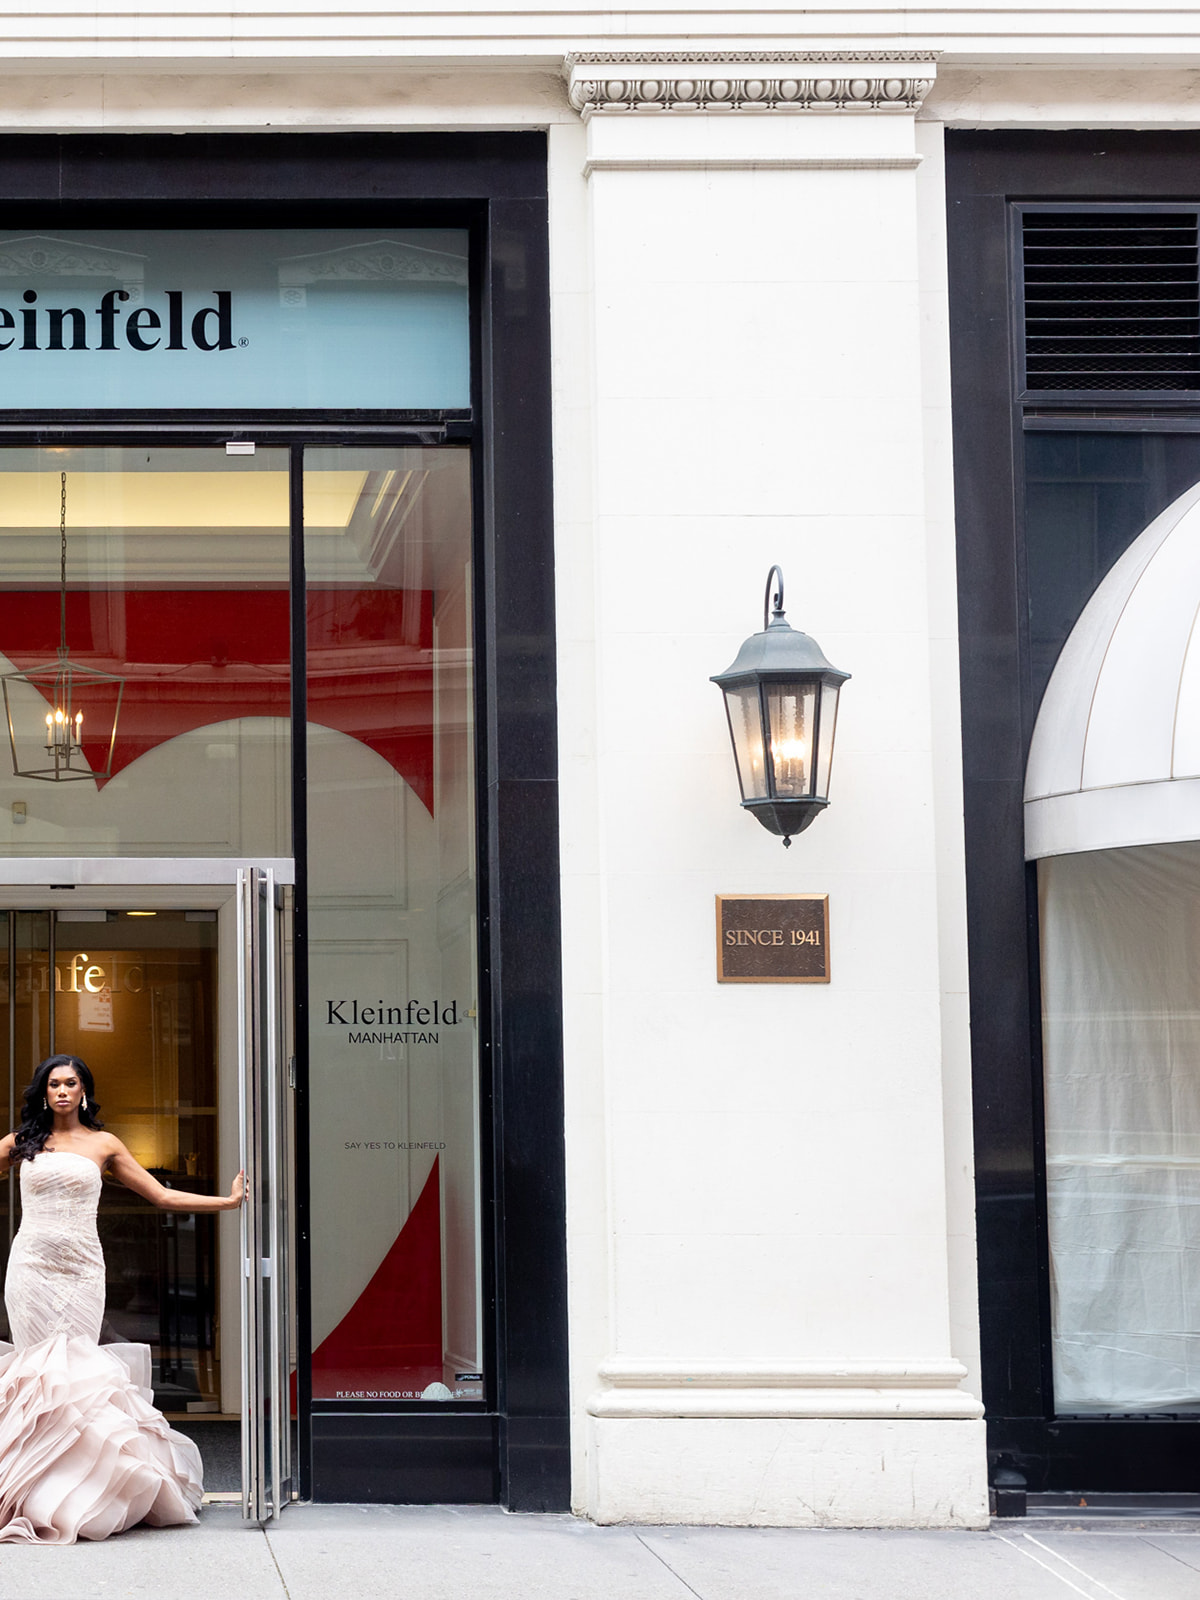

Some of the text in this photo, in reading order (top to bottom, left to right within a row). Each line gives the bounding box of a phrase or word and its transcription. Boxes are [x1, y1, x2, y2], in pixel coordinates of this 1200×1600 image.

[726, 929, 821, 946] SINCE 1941
[325, 1000, 458, 1025] Kleinfeld
[348, 1032, 439, 1044] MANHATTAN
[344, 1142, 446, 1150] SAY YES TO KLEINFELD
